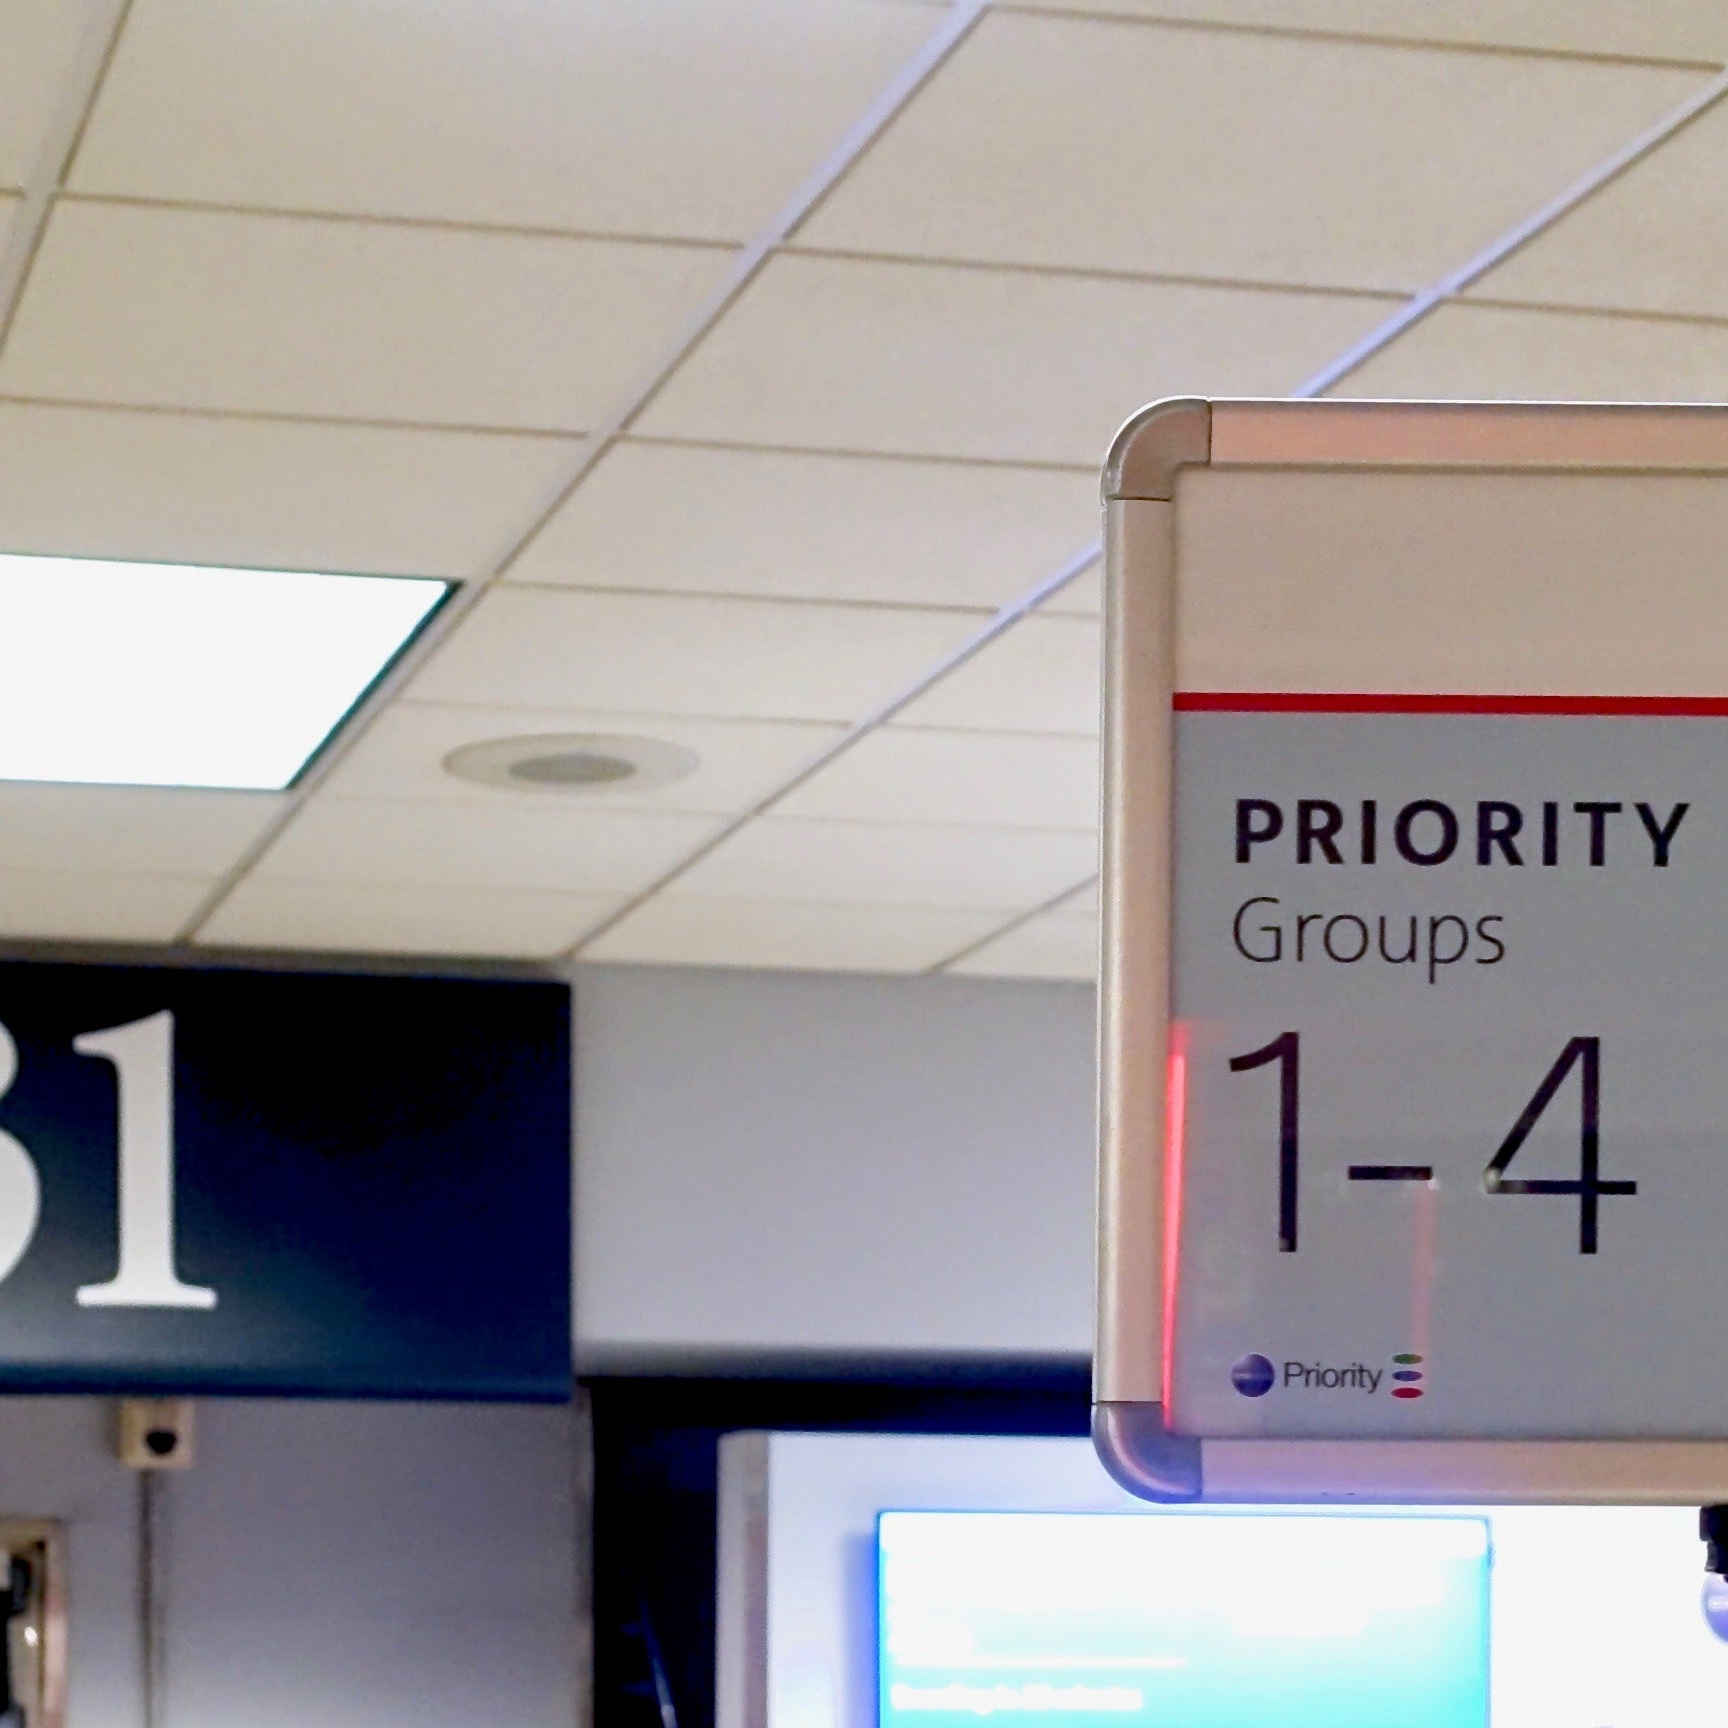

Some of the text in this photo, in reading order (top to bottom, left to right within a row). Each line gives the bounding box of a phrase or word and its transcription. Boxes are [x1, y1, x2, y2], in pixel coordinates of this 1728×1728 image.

[1233, 799, 1691, 867] PRIORITY
[1232, 896, 1507, 984] Groups
[1283, 1362, 1384, 1394] Priority
